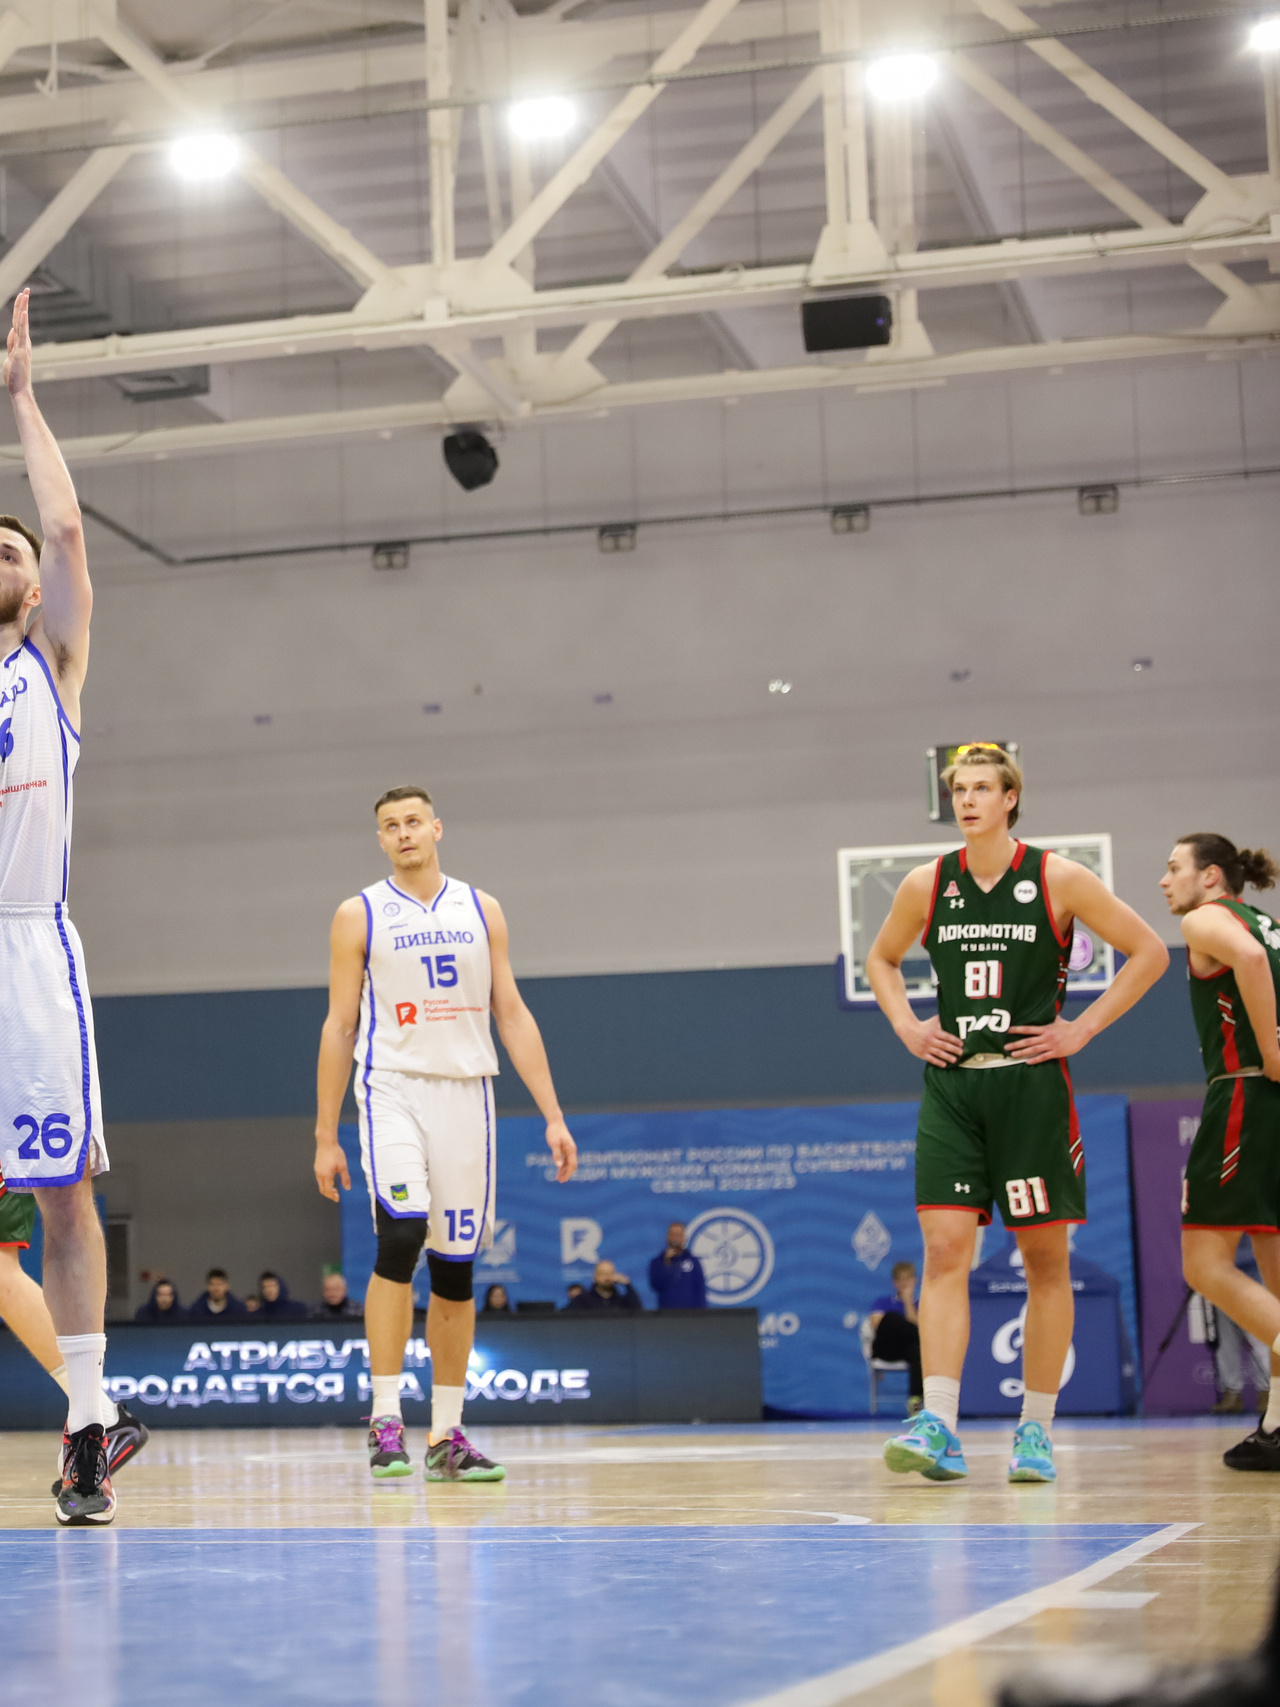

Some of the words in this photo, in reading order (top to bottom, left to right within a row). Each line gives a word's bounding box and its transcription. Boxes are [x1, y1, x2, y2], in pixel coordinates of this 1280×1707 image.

[394, 930, 474, 951] ДИНАМО
[938, 923, 1037, 944] ЛОКОМОТИВ
[961, 943, 1007, 952] КУБАНЬ
[420, 954, 458, 989] 15
[965, 960, 1003, 999] 81
[12, 1112, 73, 1160] 26
[578, 1148, 682, 1166] ЕМПИОНАТ
[545, 1166, 607, 1182] СЕДИ
[1006, 1177, 1050, 1217] 81
[444, 1209, 475, 1242] 15
[464, 1368, 592, 1405] ХОДЕ
